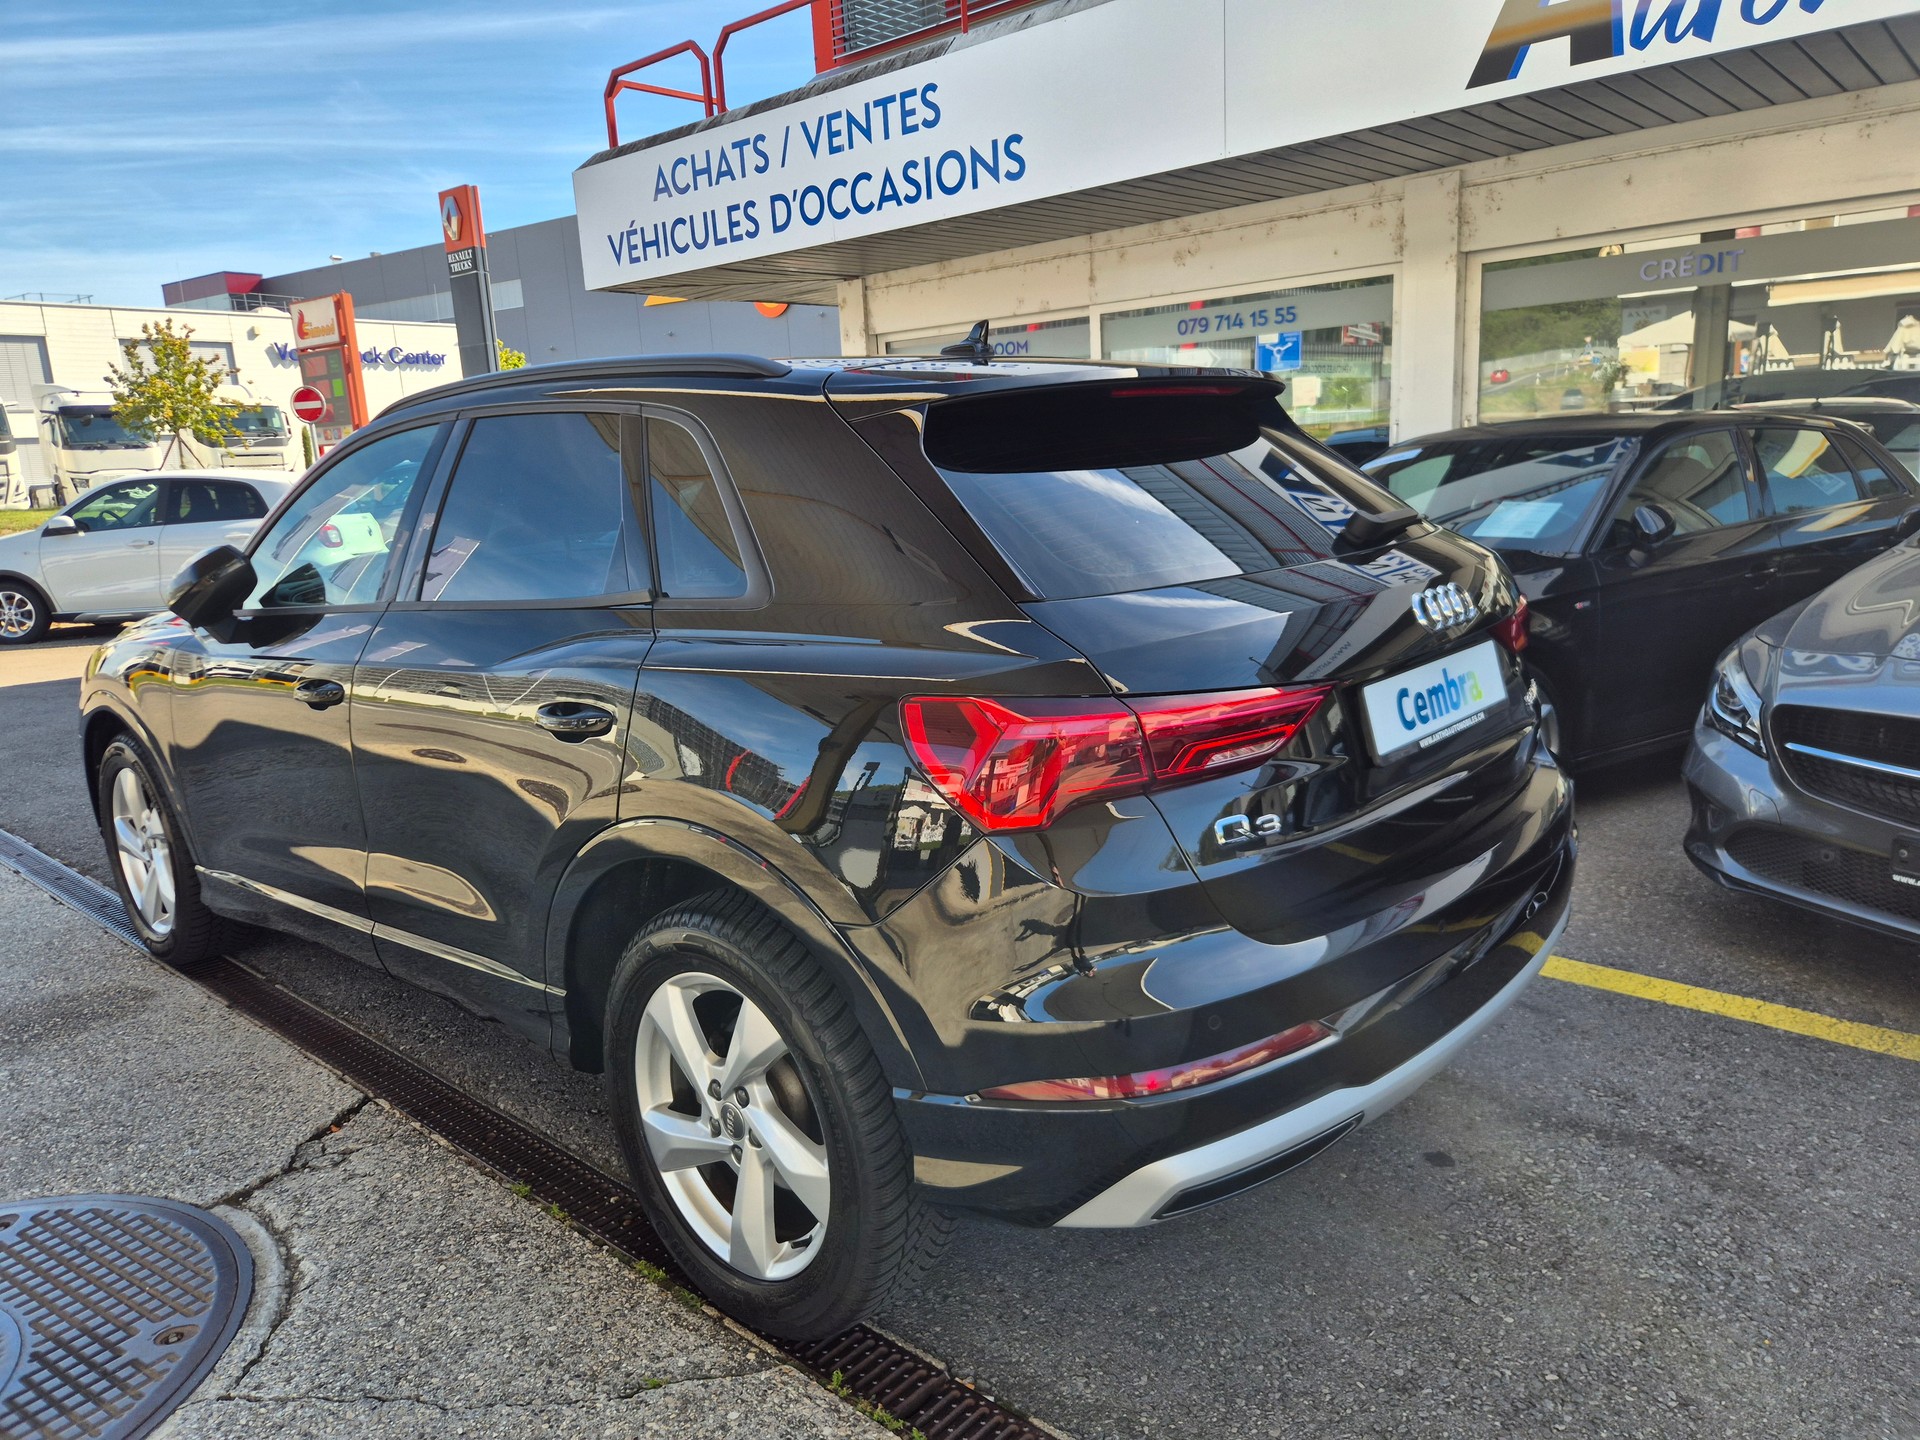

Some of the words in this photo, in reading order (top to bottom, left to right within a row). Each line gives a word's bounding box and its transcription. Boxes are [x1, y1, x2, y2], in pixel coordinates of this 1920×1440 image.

[653, 133, 770, 202] ACHATS
[781, 125, 791, 168] /
[800, 82, 942, 160] VENTES
[607, 199, 761, 267] VÉHICULES
[771, 133, 1027, 234] D'OCCASIONS
[447, 249, 473, 264] RENAULT
[450, 259, 473, 273] TRUCKS
[1639, 249, 1745, 282] CRÉDIT
[1177, 317, 1209, 336] 079
[1214, 313, 1244, 332] 714
[1250, 309, 1269, 327] 15
[1275, 305, 1297, 324] 55
[388, 346, 447, 365] Center
[994, 340, 1028, 355] OOM
[1396, 667, 1484, 731] Cembra
[1214, 813, 1282, 845] Q3
